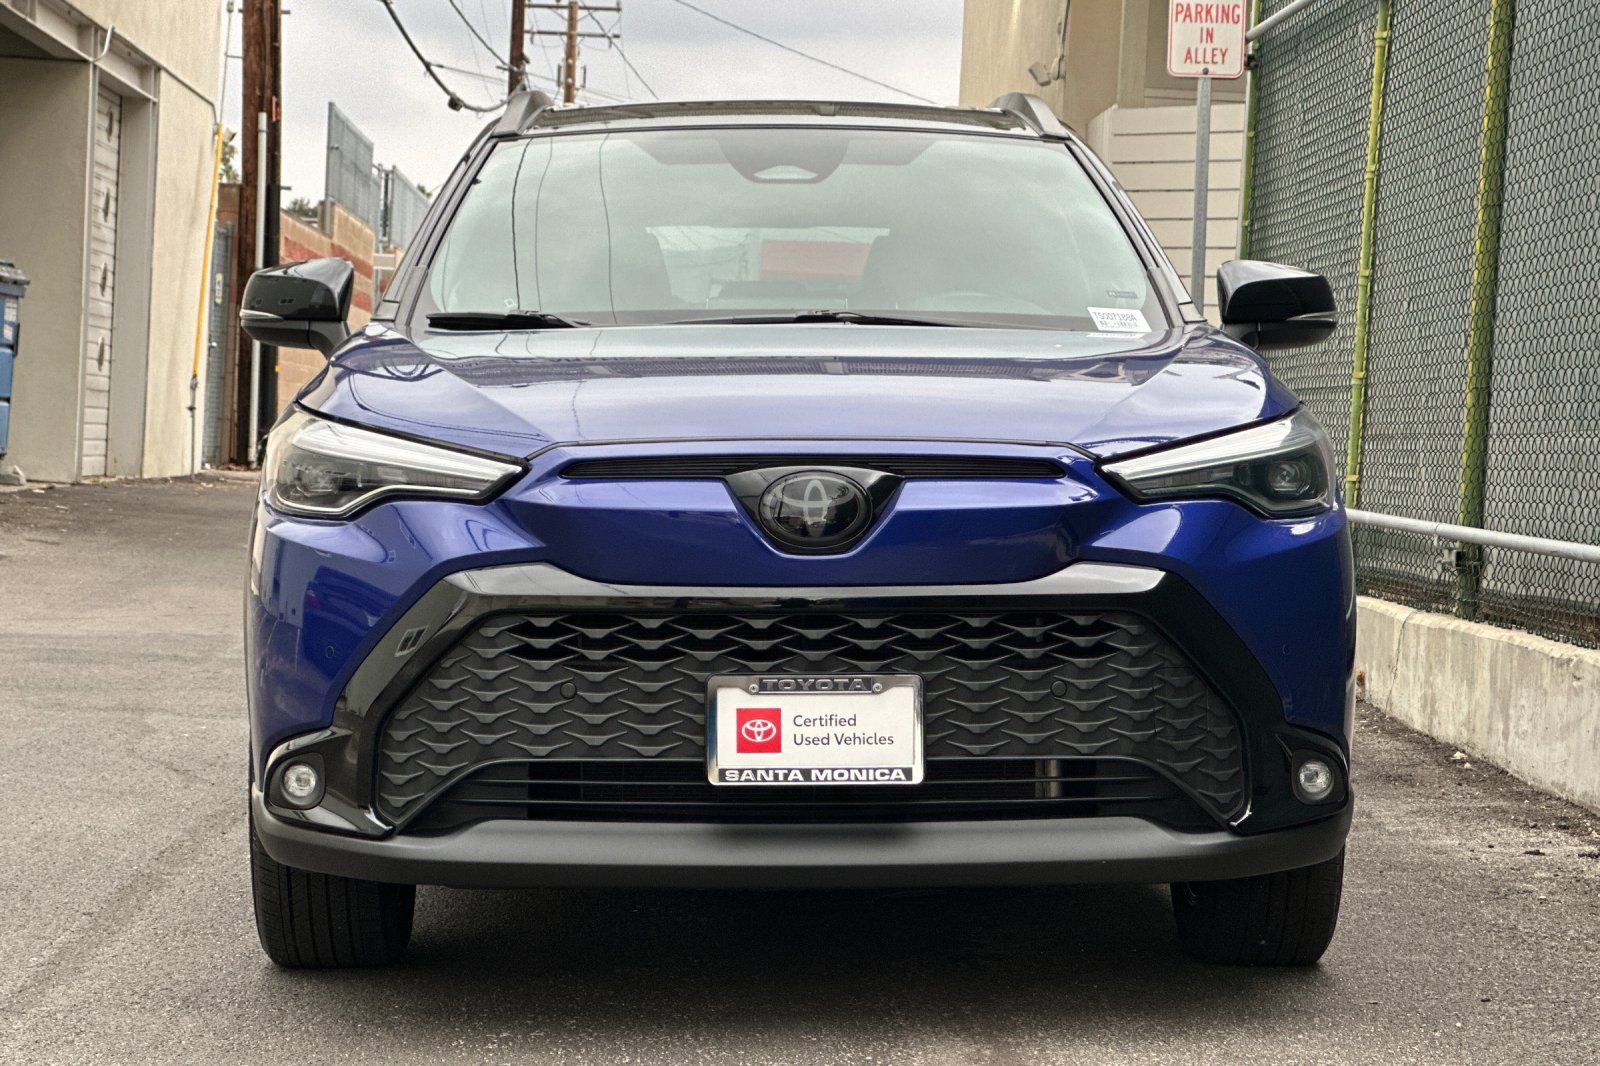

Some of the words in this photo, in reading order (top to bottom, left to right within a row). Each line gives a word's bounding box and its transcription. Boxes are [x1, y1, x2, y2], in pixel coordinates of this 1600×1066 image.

[1175, 3, 1241, 24] PARKING
[1200, 27, 1214, 43] IN
[1184, 47, 1228, 64] ALLEY
[762, 679, 868, 691] TOYOTA
[793, 714, 857, 727] Certified
[793, 733, 830, 746] Used
[835, 733, 894, 746] Vehicles
[725, 769, 804, 781] SANTA
[811, 769, 906, 781] MONICA
